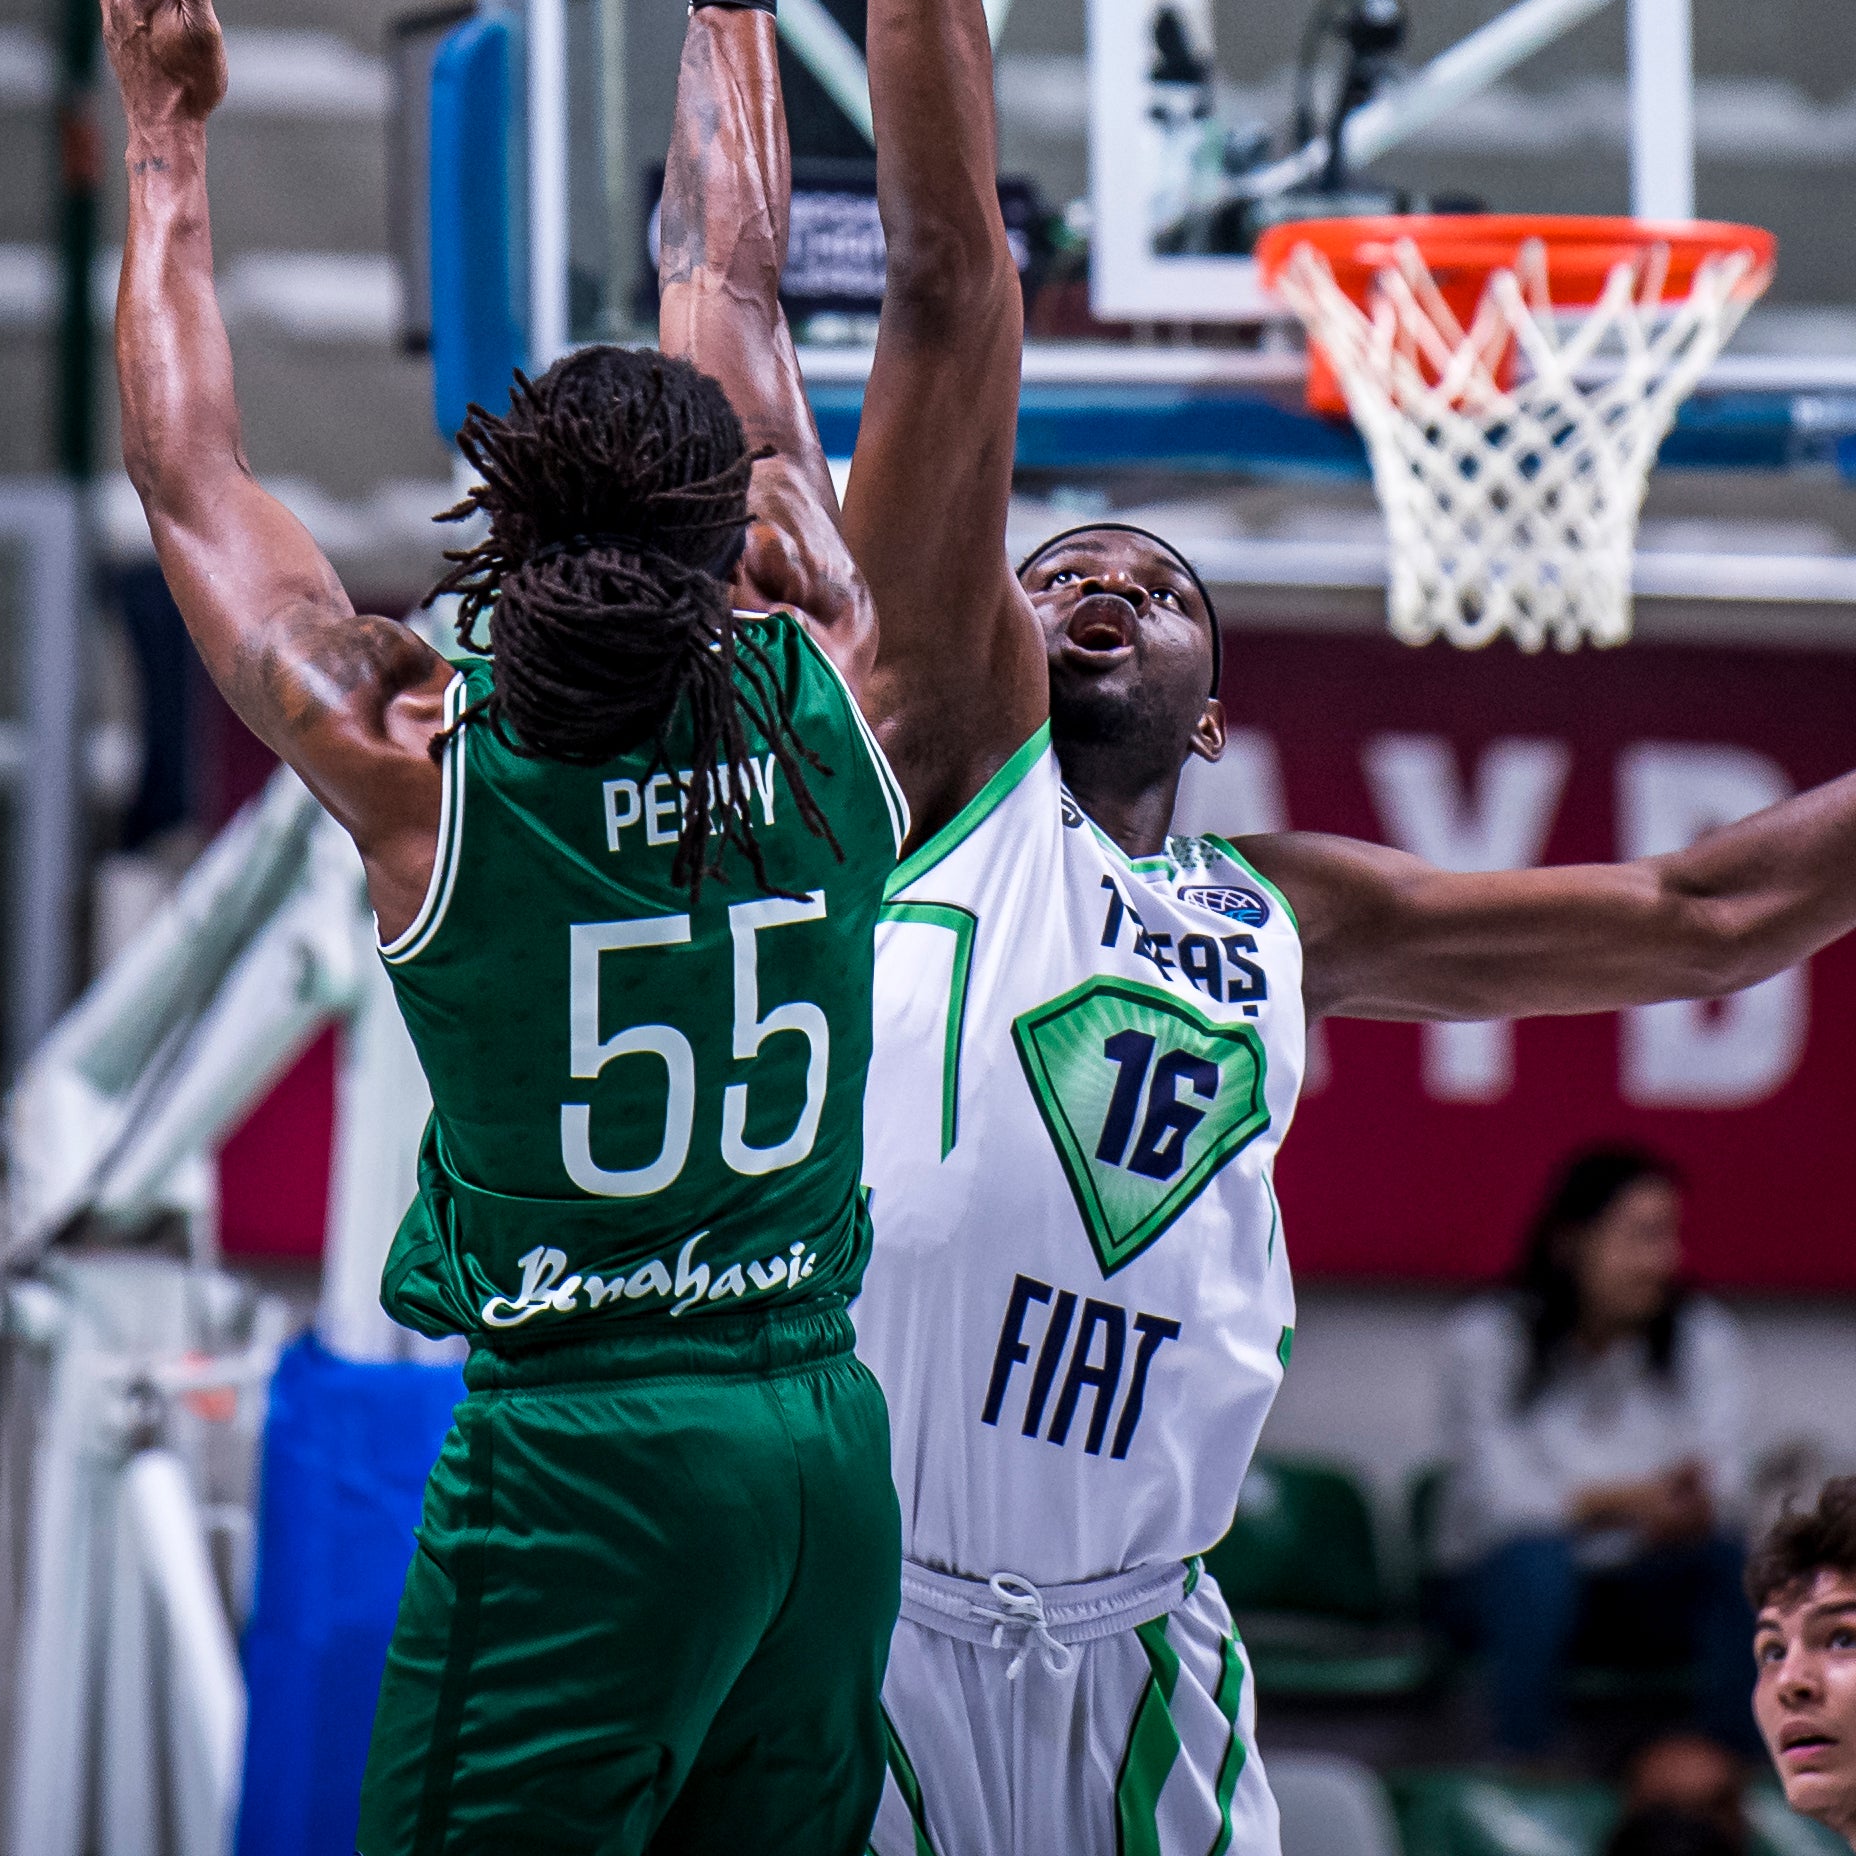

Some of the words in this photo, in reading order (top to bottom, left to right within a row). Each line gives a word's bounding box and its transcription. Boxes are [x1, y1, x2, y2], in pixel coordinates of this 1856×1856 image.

[559, 889, 830, 1199] 55
[1095, 1028, 1219, 1181] 16
[981, 1273, 1181, 1460] FIAT
